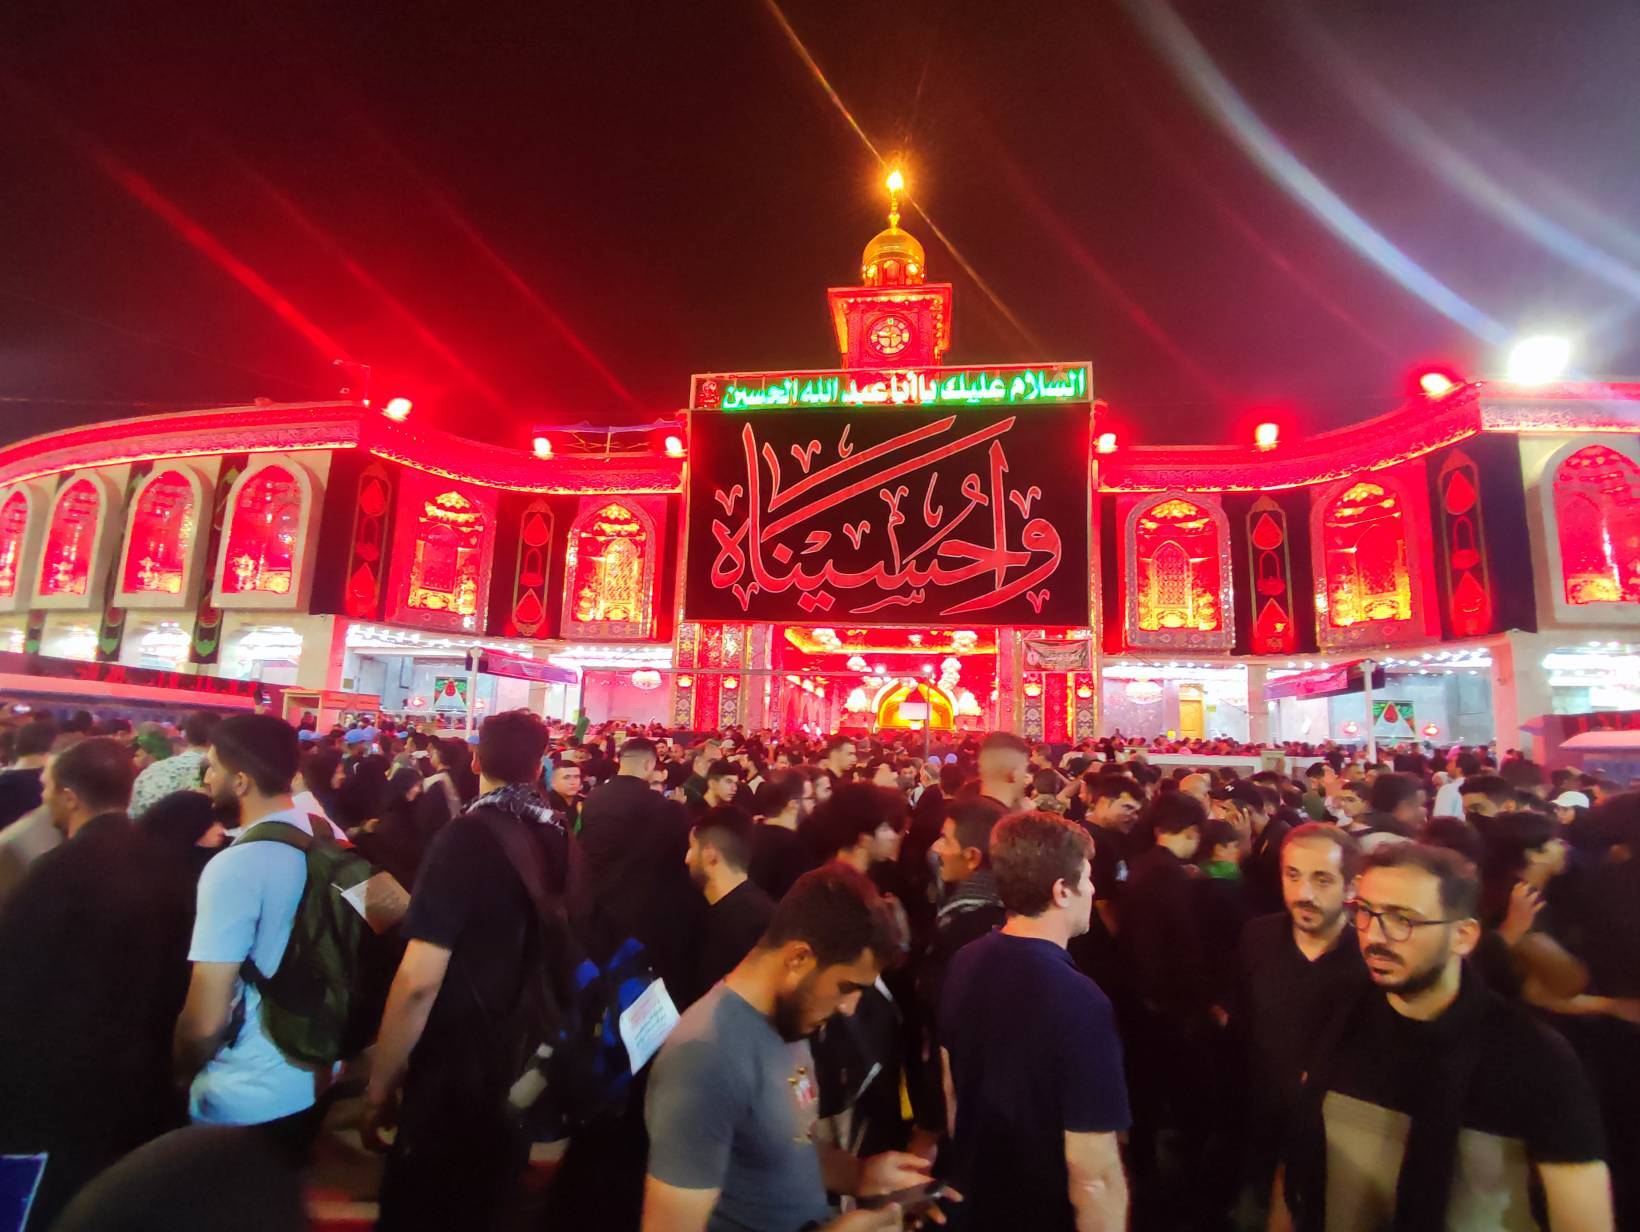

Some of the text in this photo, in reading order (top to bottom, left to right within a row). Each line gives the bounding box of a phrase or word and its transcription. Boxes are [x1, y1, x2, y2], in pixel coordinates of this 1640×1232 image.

[723, 377, 799, 410] الحسين
[799, 376, 839, 403] الله
[841, 378, 889, 406] عبد
[918, 373, 938, 404] يا
[940, 371, 1006, 403] عليك
[1009, 367, 1086, 402] السلام
